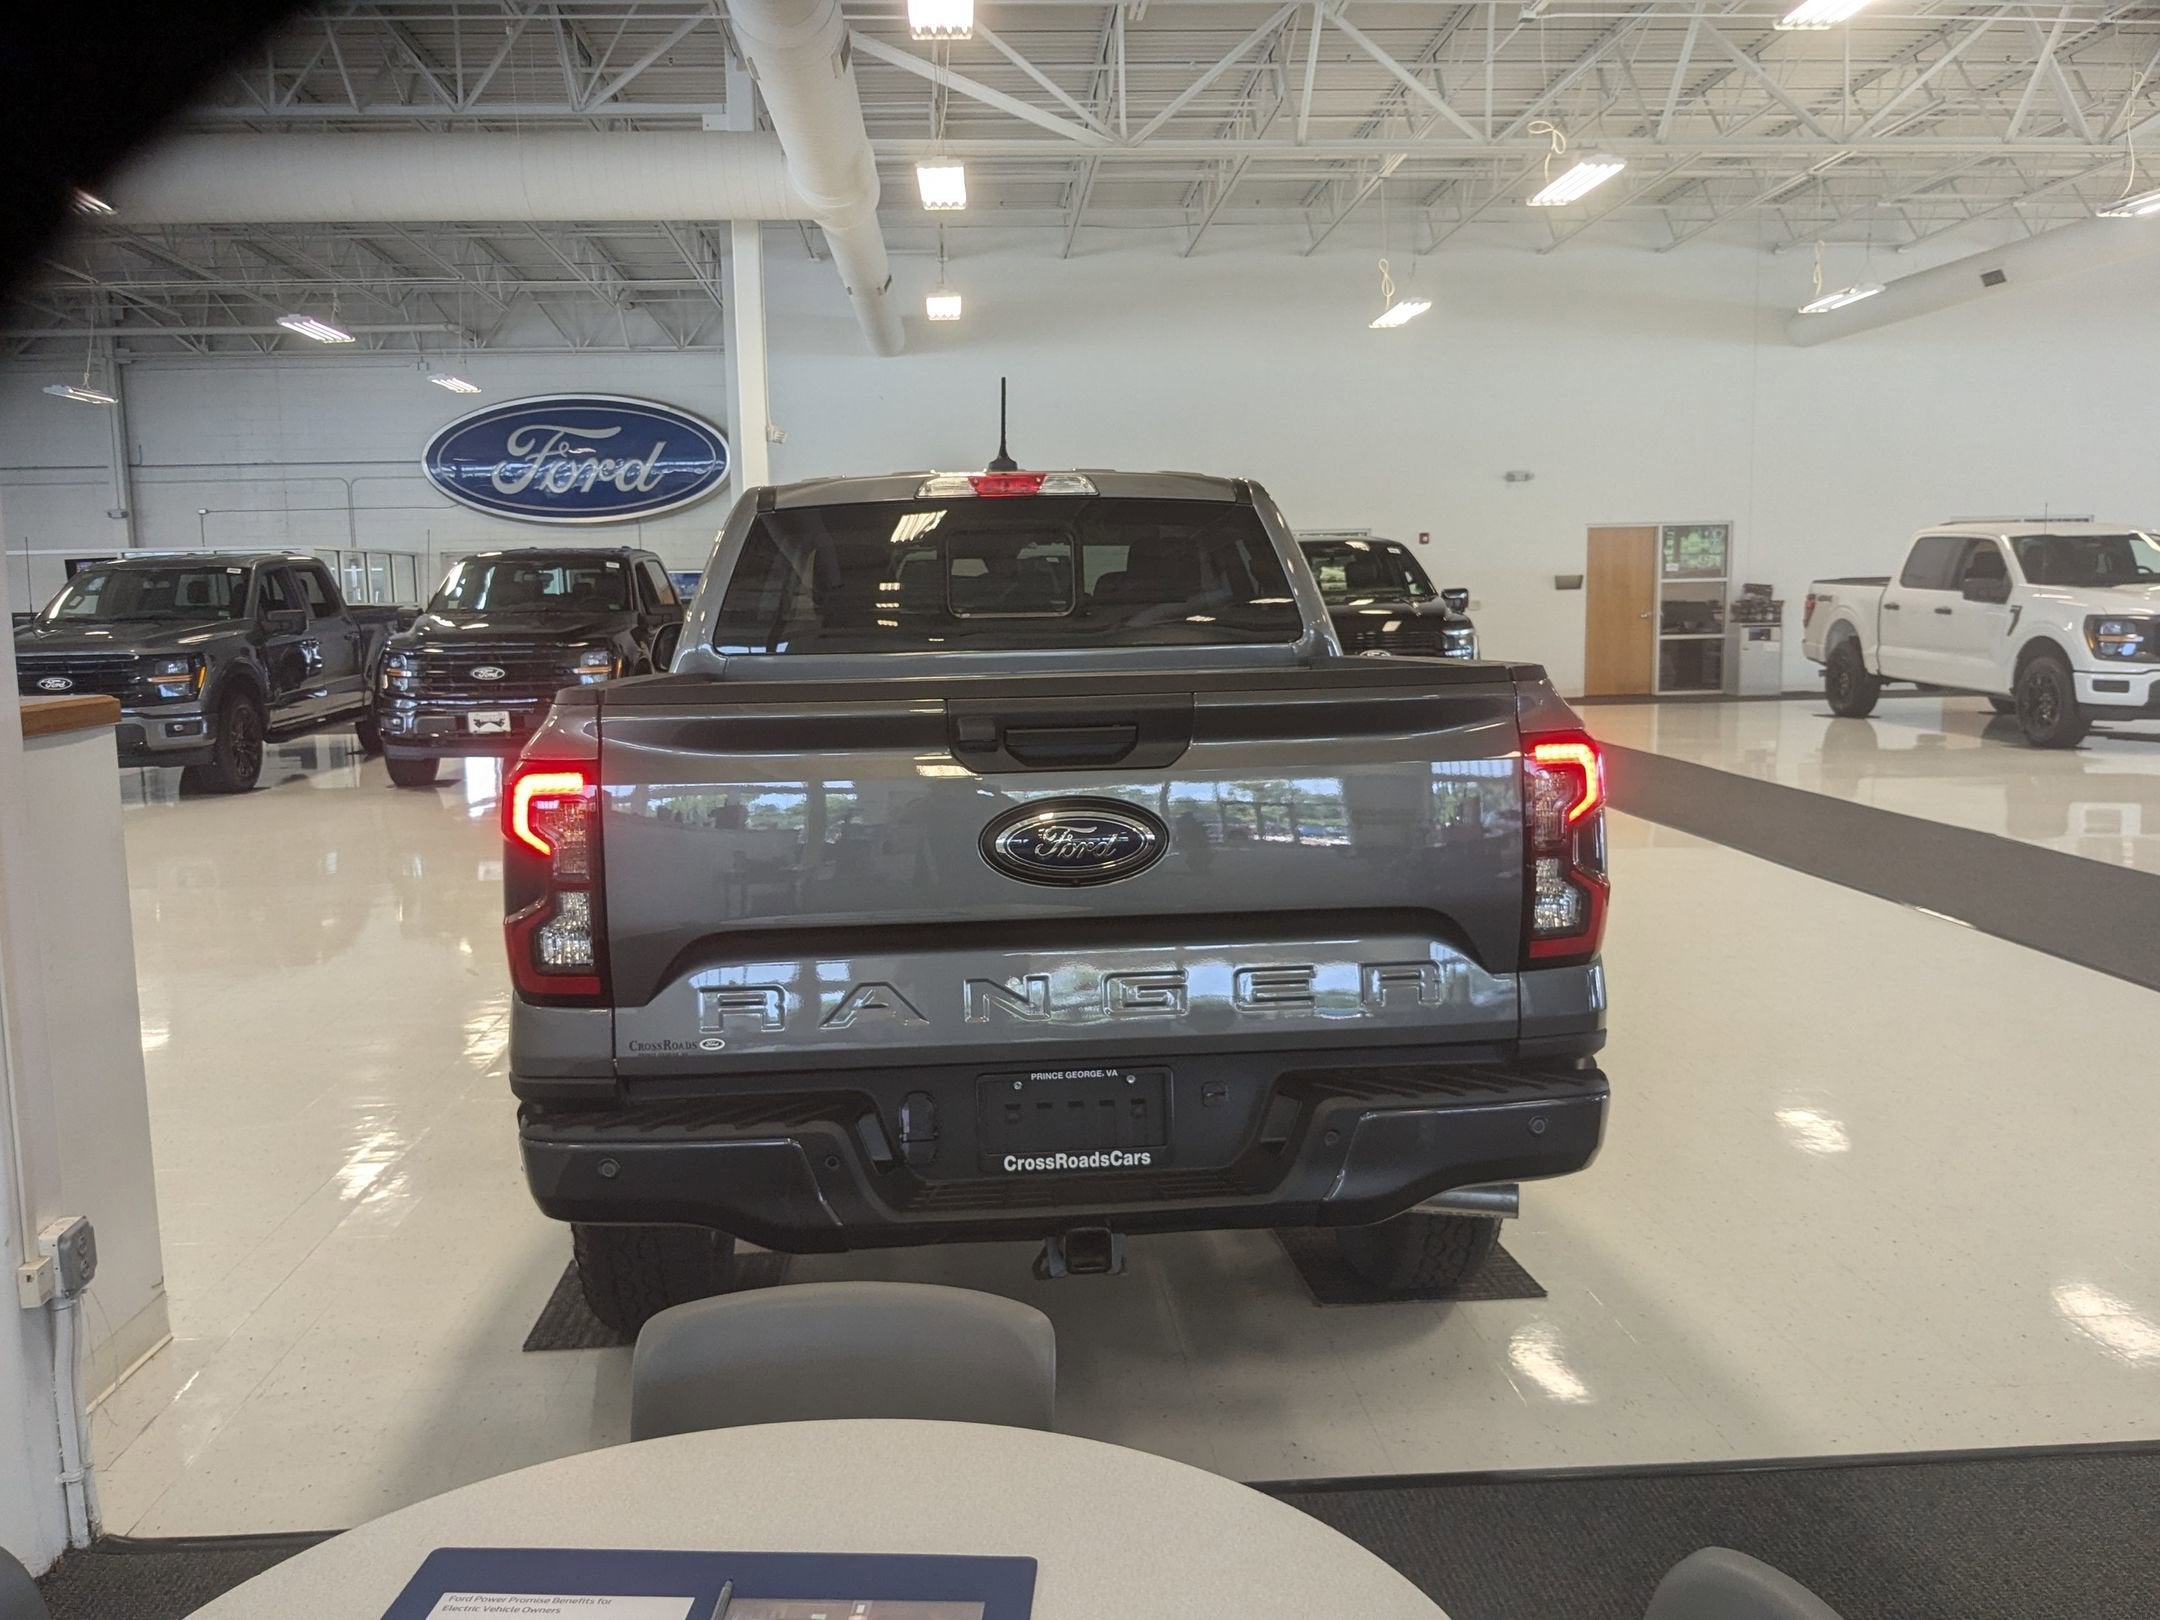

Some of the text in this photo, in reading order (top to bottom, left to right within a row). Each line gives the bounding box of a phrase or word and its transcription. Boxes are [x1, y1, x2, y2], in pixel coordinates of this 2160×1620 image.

[491, 424, 667, 495] Ford
[1034, 825, 1118, 858] Ford
[698, 960, 1442, 1033] RANGER
[1030, 1072, 1064, 1080] PRINCE
[1106, 1069, 1118, 1077] VA
[1003, 1150, 1152, 1171] CrossRoadsCars
[442, 1604, 561, 1614] Electric Vehicle Owners
[509, 1596, 550, 1604] Promise
[551, 1597, 596, 1605] Benefits
